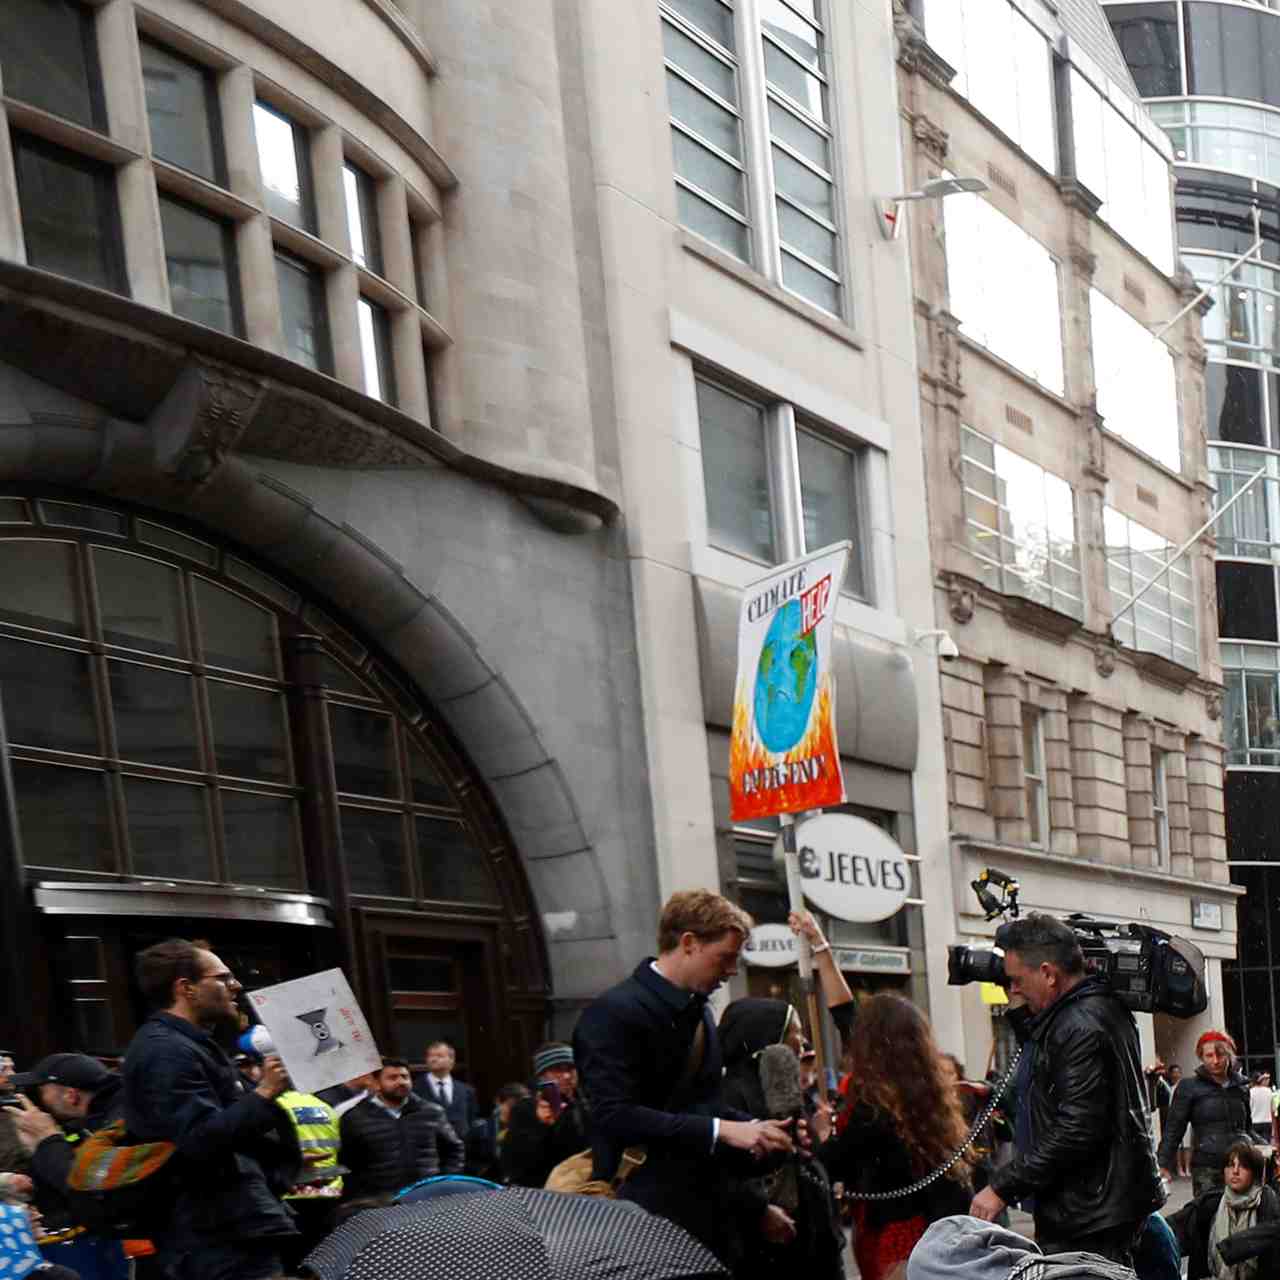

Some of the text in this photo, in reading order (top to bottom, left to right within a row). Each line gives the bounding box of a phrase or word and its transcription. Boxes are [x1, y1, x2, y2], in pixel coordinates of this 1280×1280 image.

[747, 567, 807, 623] CLIMATE
[801, 577, 831, 634] HELP
[824, 851, 905, 892] JEEVES
[758, 939, 794, 952] JEEVE
